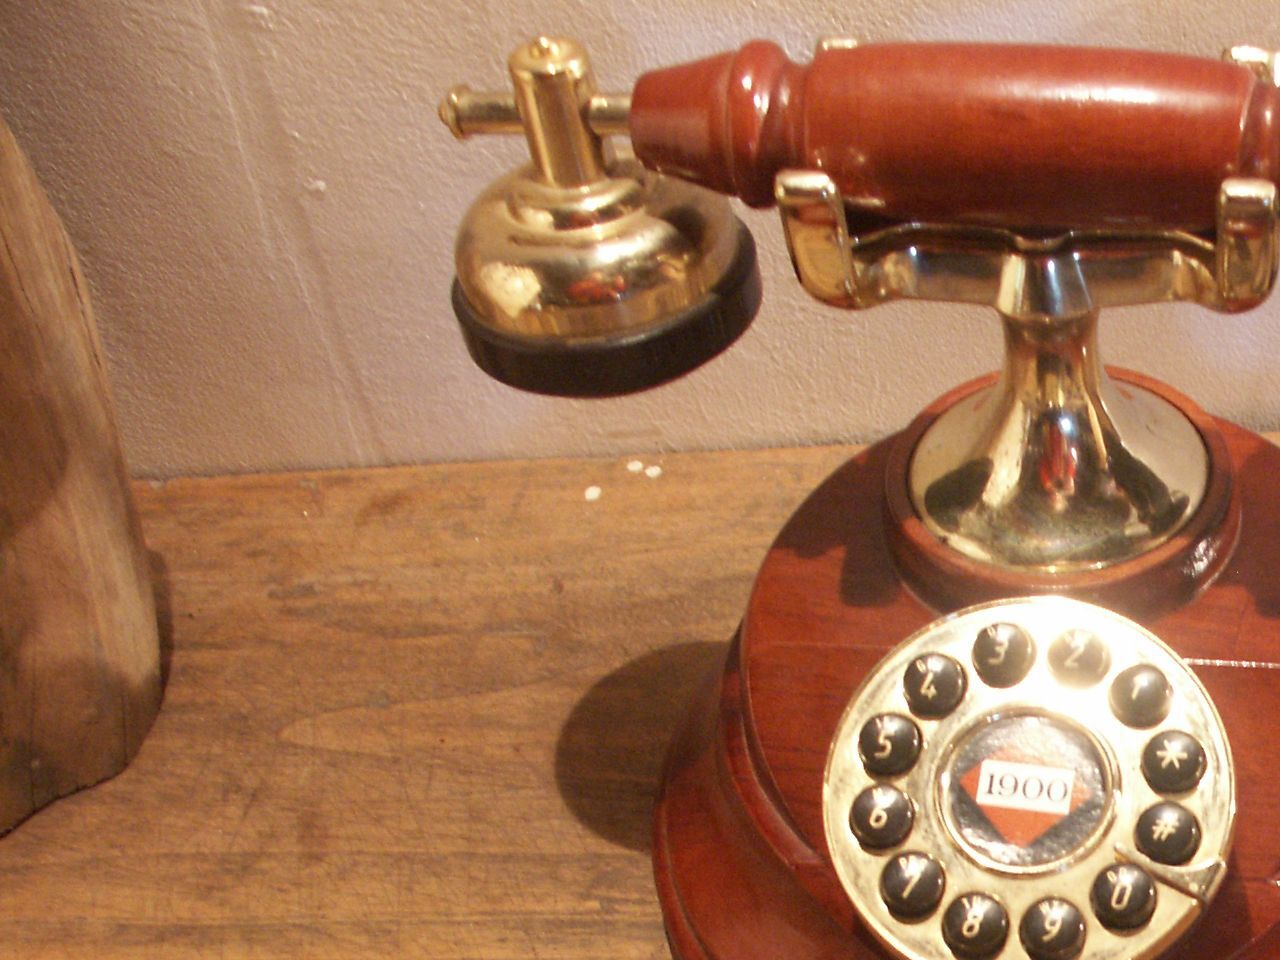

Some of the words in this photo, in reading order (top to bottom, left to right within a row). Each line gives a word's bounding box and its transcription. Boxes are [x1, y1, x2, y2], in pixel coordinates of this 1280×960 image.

[920, 671, 937, 700] 4
[874, 731, 897, 759] 5
[986, 773, 1068, 801] 1900
[868, 800, 889, 829] 6
[1111, 882, 1133, 910] 0
[961, 909, 984, 938] 8
[1043, 911, 1063, 942] 9
